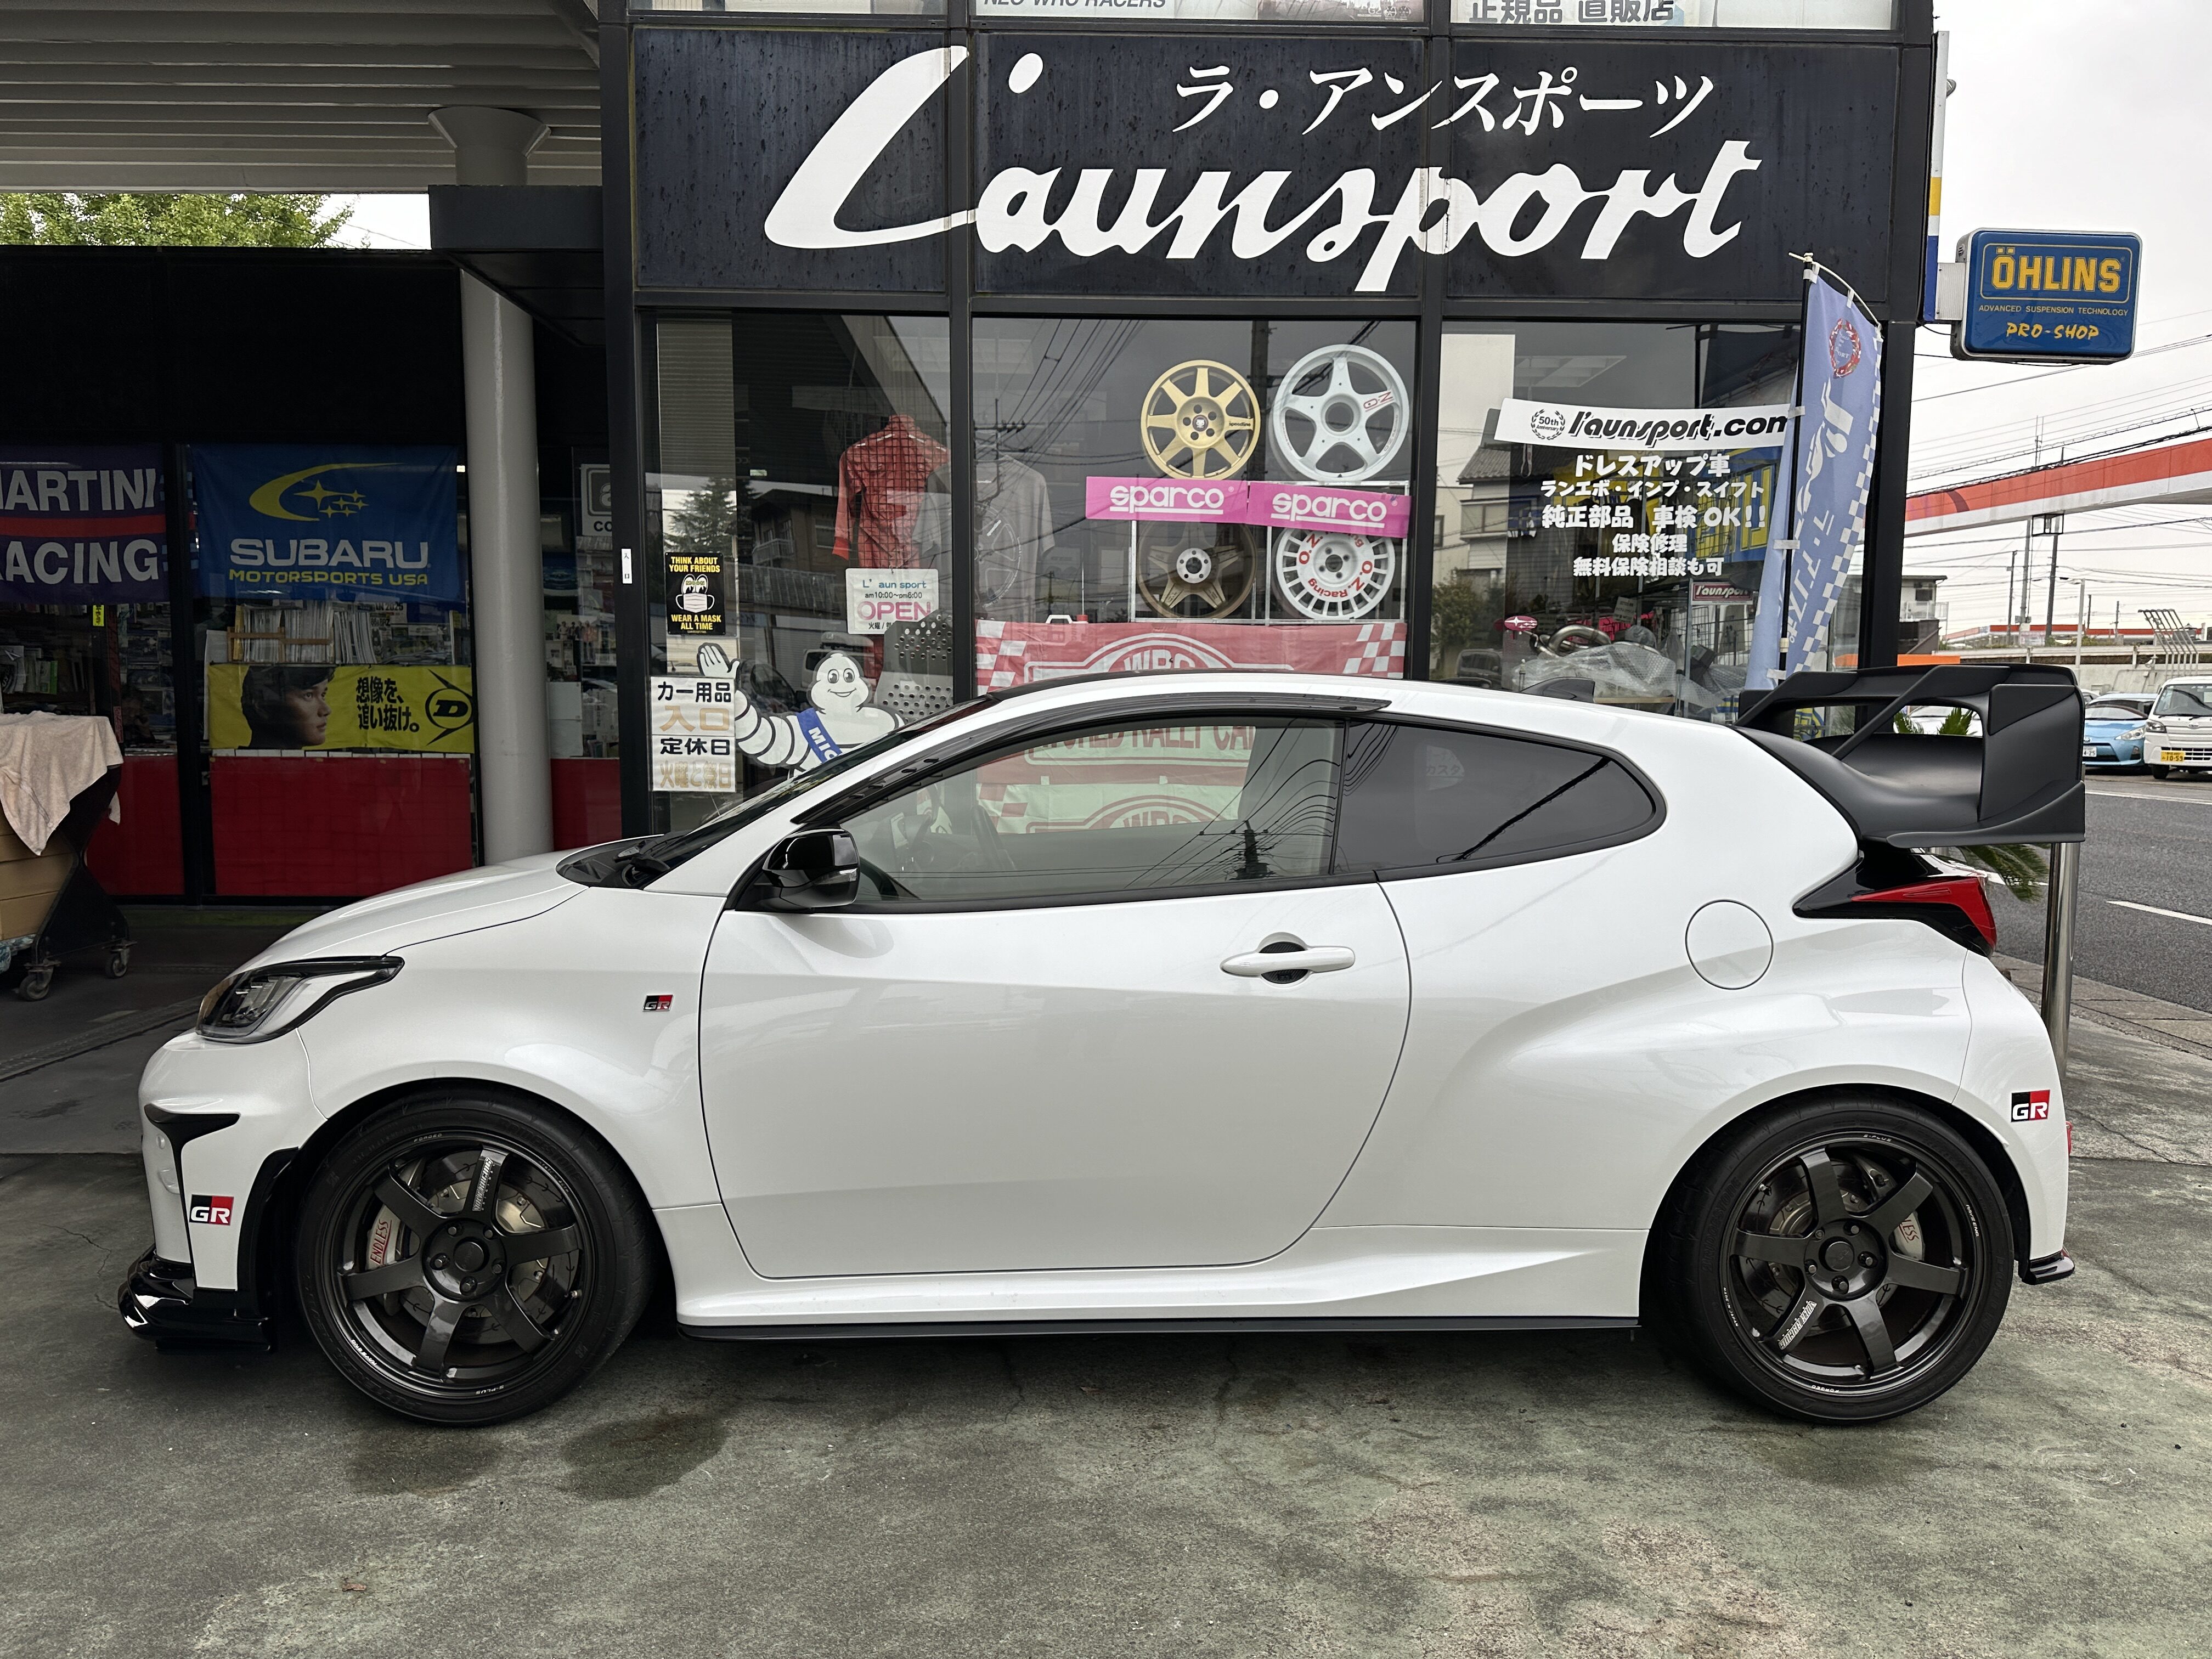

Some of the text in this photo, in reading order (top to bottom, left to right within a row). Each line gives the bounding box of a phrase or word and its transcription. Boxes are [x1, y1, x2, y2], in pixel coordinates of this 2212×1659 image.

[1172, 64, 1714, 138] ラ・アンスポーツ
[1991, 246, 2122, 293] ÖHLINS
[2025, 306, 2074, 314] SUSPENSION
[2078, 308, 2129, 317] TECHNOLOGY
[1538, 415, 1559, 426] 50th
[1576, 453, 1730, 477] ドレスアップ車
[0, 468, 156, 511] ARTINI
[1541, 479, 1764, 498] ランエボ・インプ・スイフト
[1110, 484, 1224, 515] sparco
[1272, 491, 1387, 524] sparco
[1542, 504, 1634, 529] 純正部品
[230, 538, 428, 569] SUBARU
[1612, 533, 1688, 554] 保険修理
[0, 538, 159, 585] ACING
[624, 552, 630, 579] 入口
[669, 564, 720, 573] YOUR FRIENDS
[670, 556, 718, 565] THINK ABOUT
[1573, 557, 1724, 577] 無料保険相談も可
[229, 569, 428, 586] MOTORSPORTS USA
[900, 580, 927, 589] sport
[671, 614, 721, 623] WEAR A MASK
[857, 601, 931, 620] OPEN
[695, 622, 713, 630] TIME
[658, 681, 731, 703] カー用品
[659, 706, 730, 732] 入口
[660, 738, 730, 755] 定休日
[661, 761, 731, 788] 火曜と祭日
[645, 1001, 670, 1009] GR
[2012, 1102, 2047, 1120] GR
[413, 1132, 443, 1143] FORGED
[190, 1206, 230, 1224] GR
[370, 1220, 388, 1265] ENDLESS
